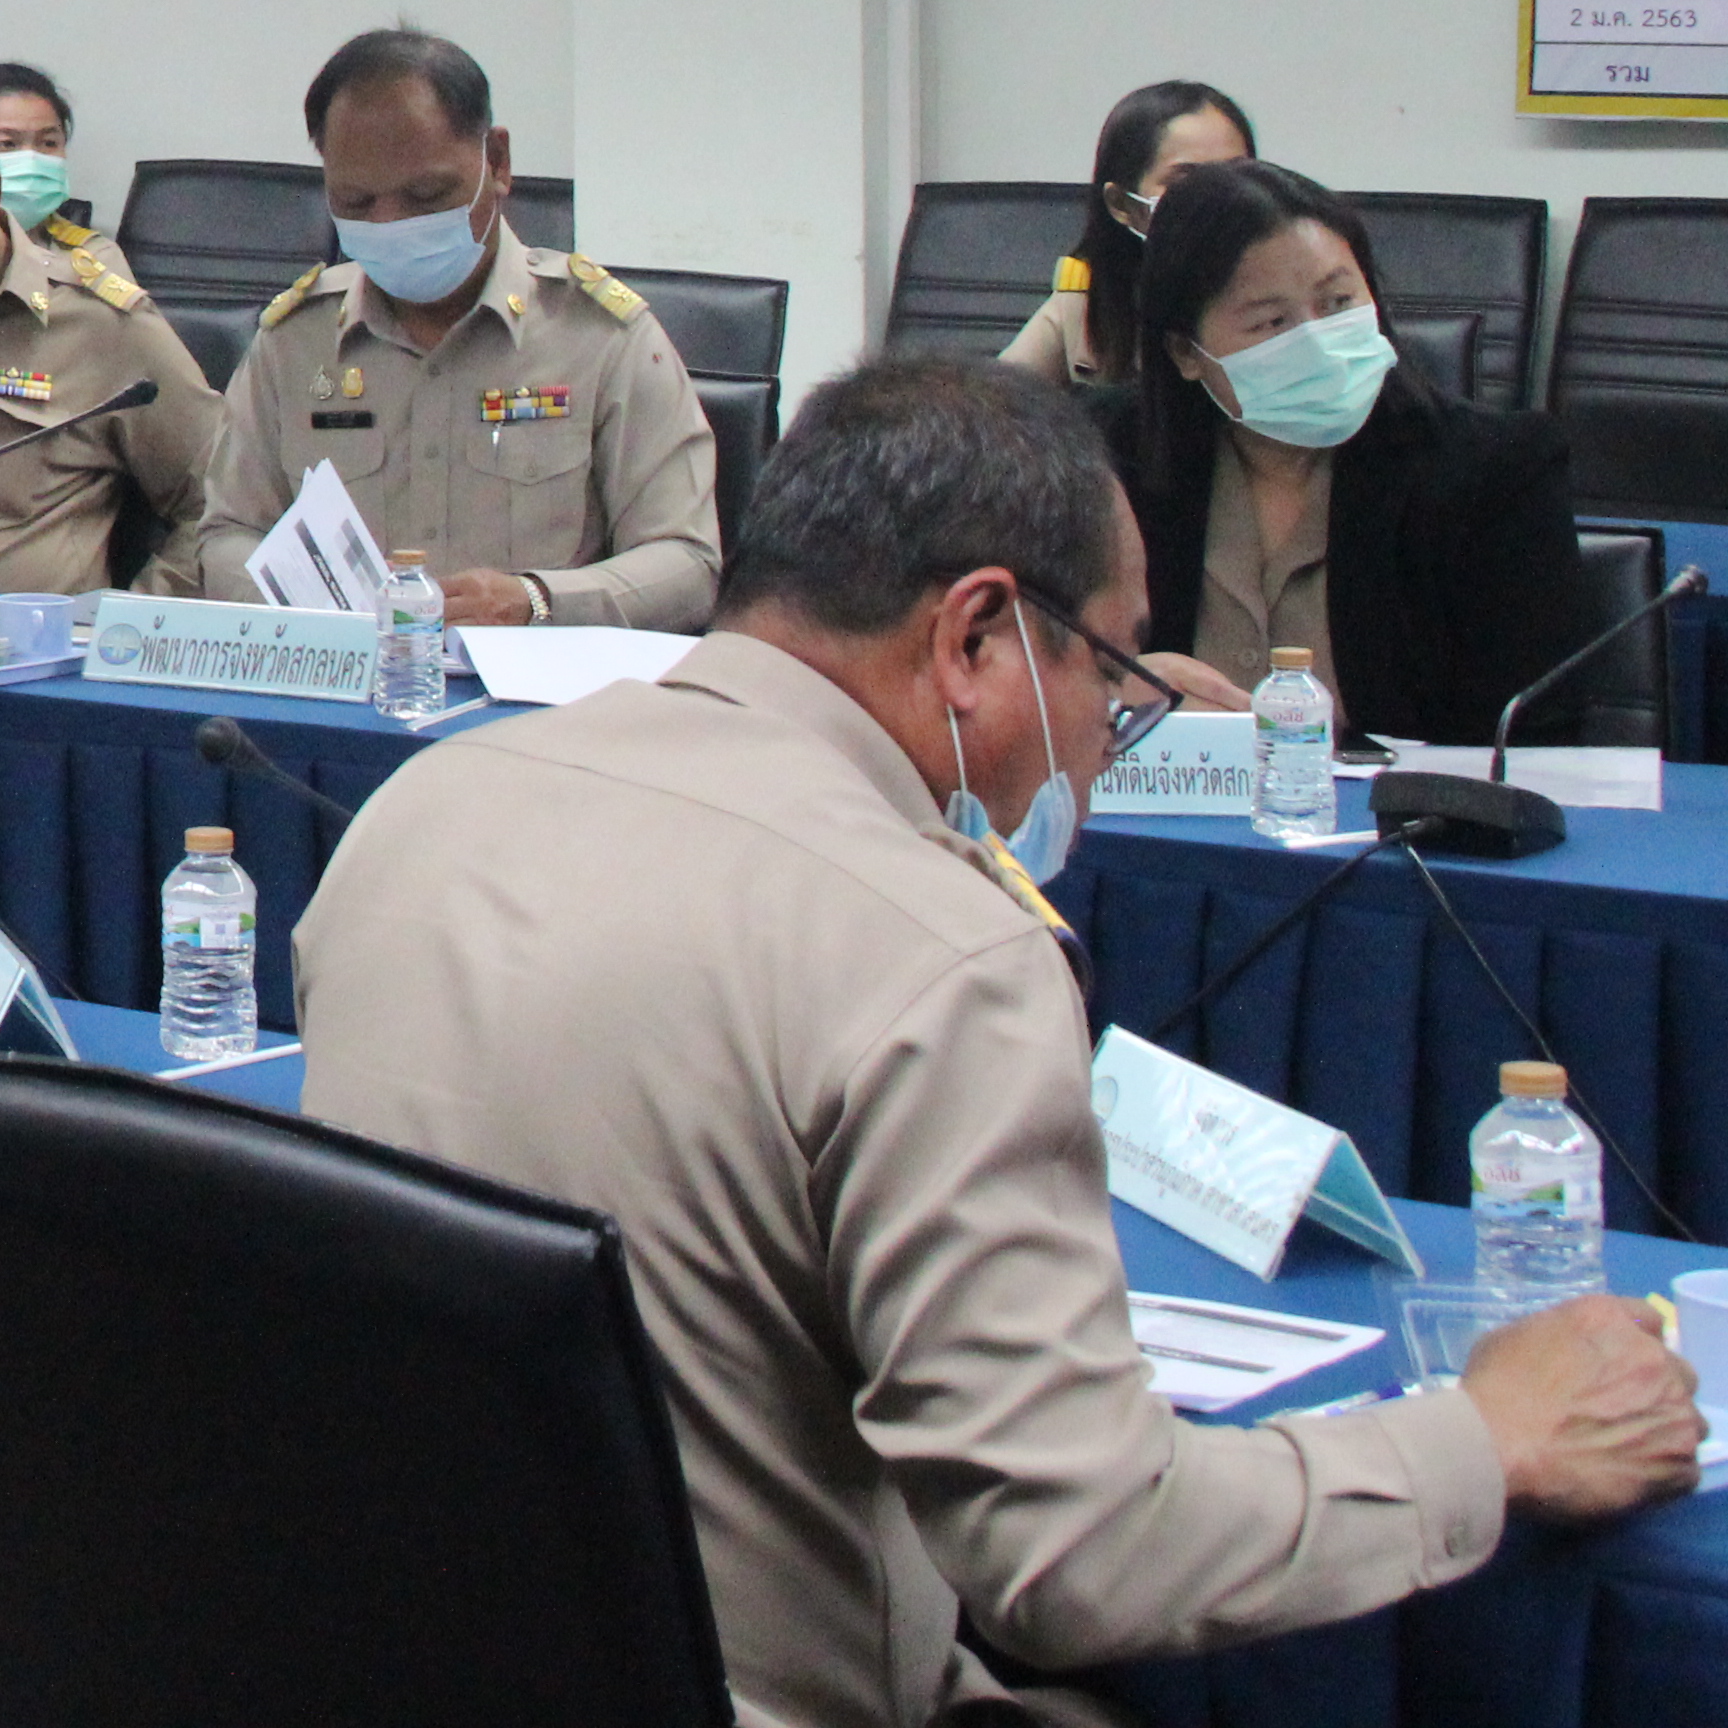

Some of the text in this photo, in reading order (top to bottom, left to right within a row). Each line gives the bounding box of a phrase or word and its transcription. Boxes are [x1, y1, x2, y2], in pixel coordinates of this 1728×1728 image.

[1570, 8, 1697, 28] 2 ม.ค. 2563
[1605, 64, 1650, 83] รวม
[138, 614, 369, 692] พัฒนาการจังหวัดสกลนคร
